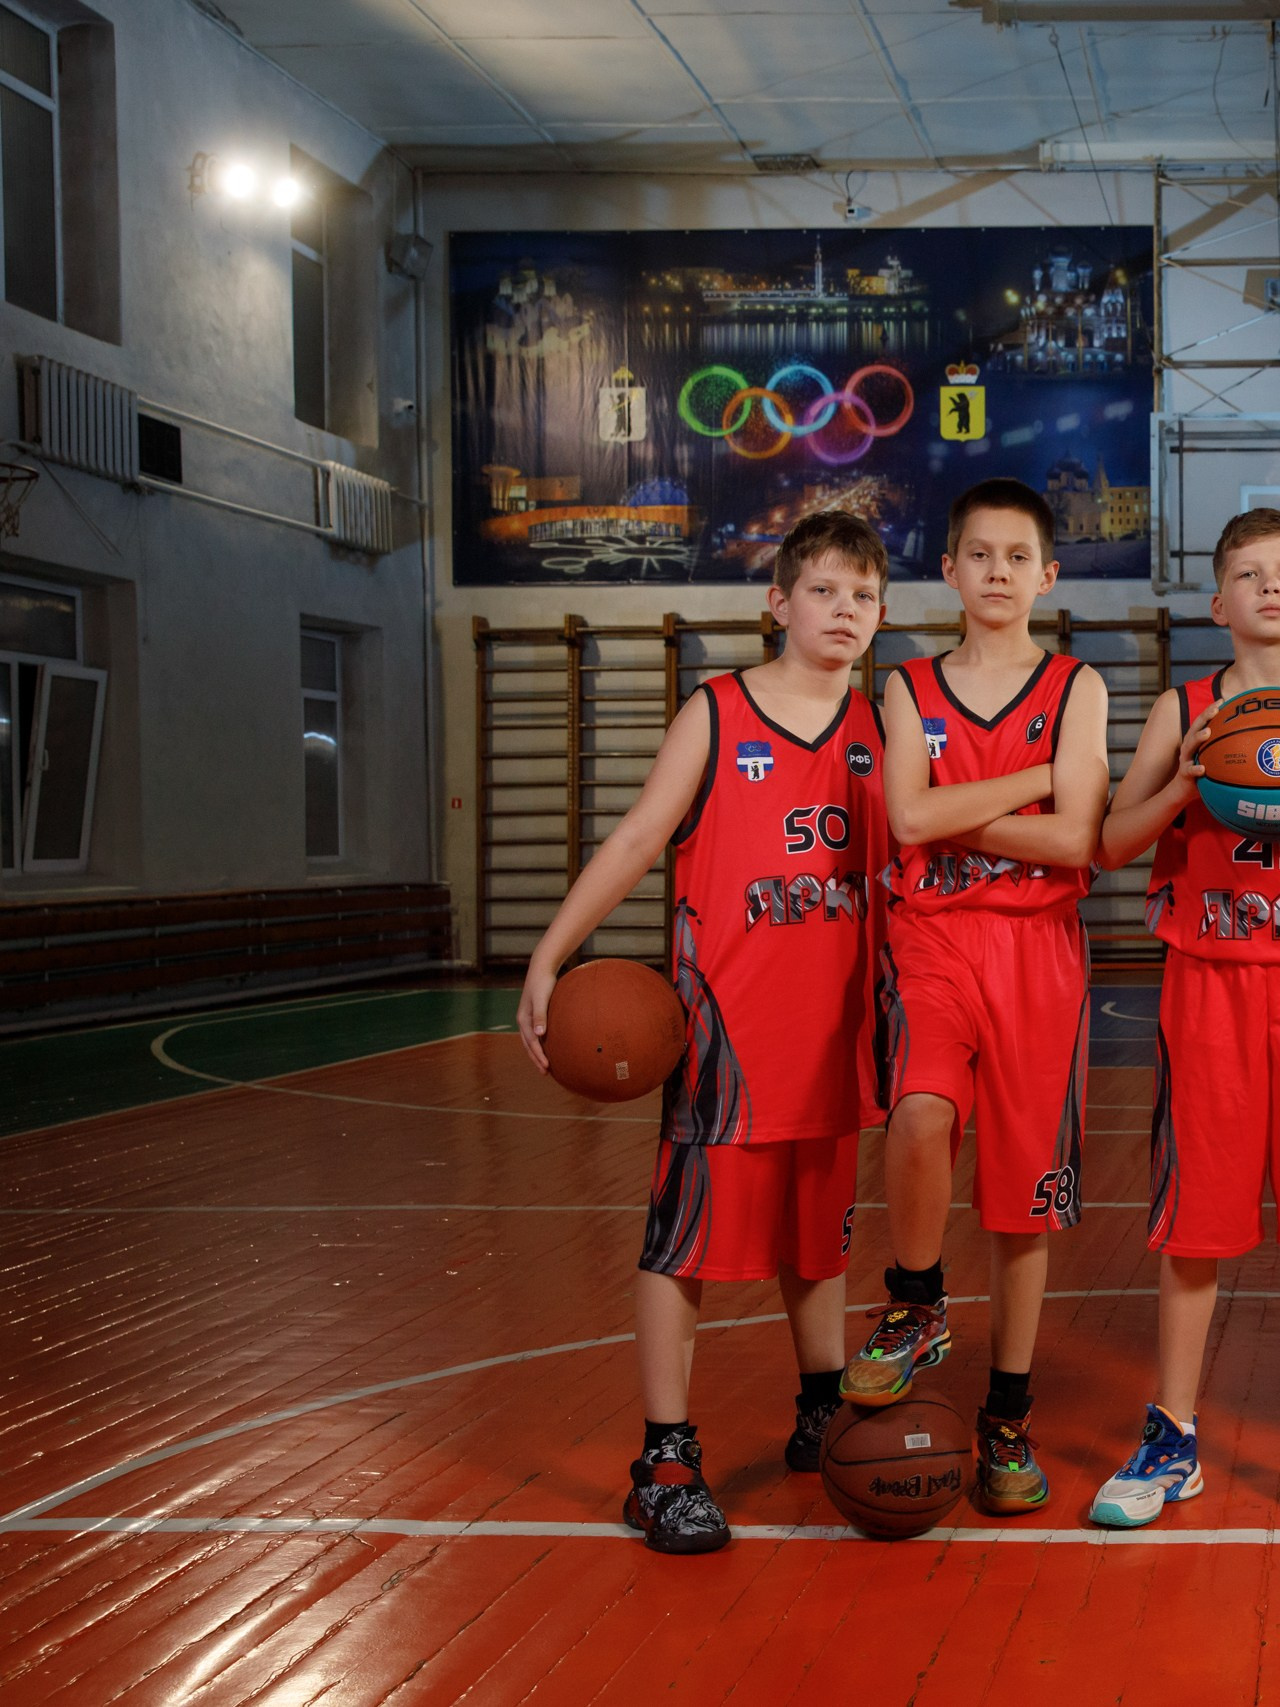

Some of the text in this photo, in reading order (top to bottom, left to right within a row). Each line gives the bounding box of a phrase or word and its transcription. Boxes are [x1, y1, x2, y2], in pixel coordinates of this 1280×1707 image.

[849, 754, 871, 764] РФБ
[783, 803, 851, 855] 50
[1028, 1165, 1075, 1217] 58
